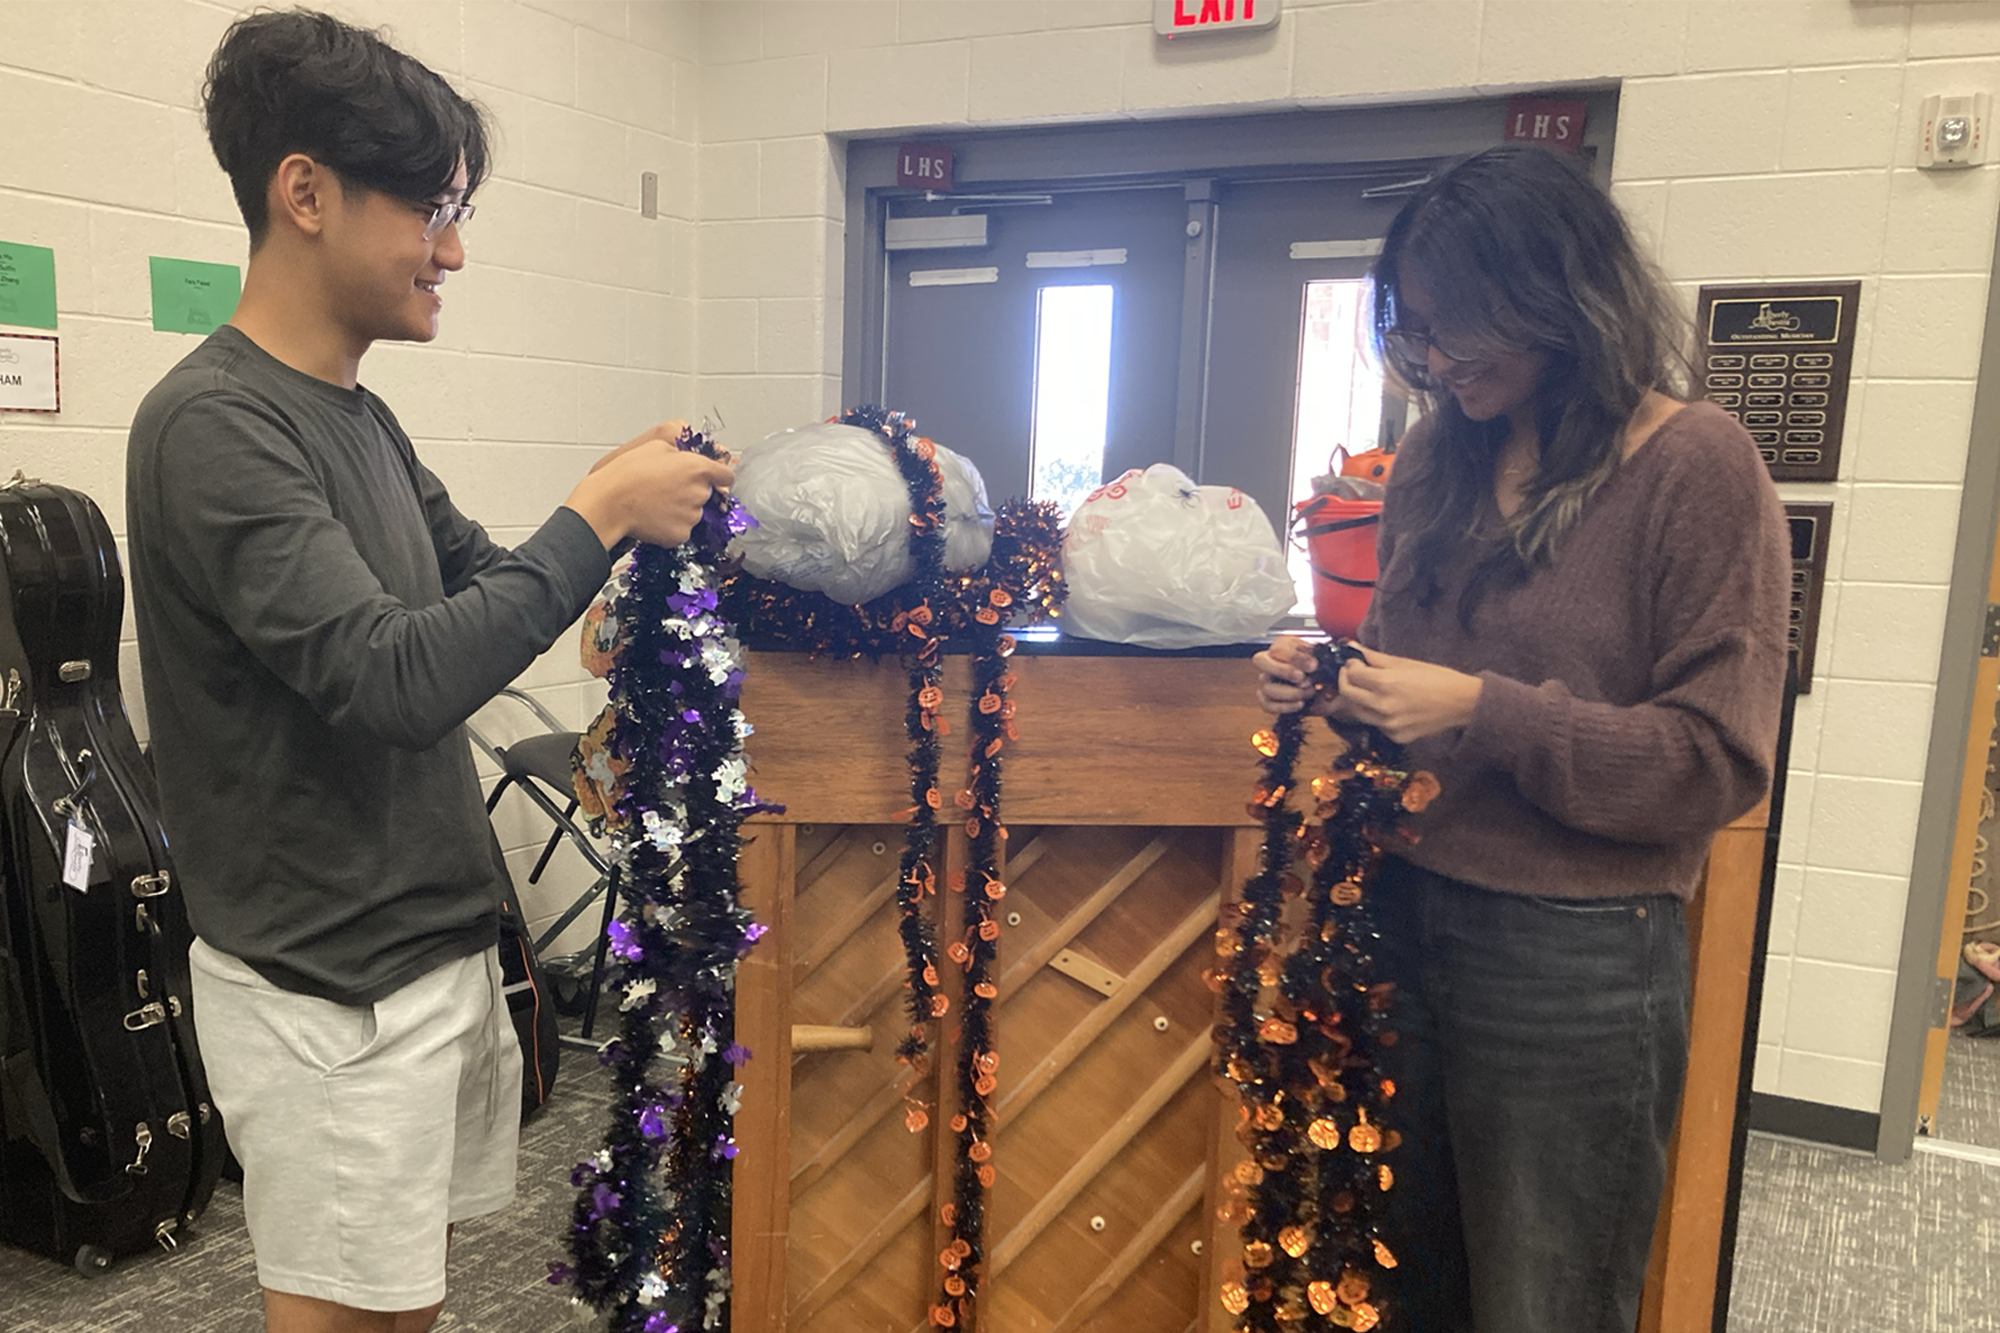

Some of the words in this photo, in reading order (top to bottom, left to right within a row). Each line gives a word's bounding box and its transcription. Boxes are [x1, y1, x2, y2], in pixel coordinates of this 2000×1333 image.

[1513, 113, 1570, 140] LHS
[1924, 120, 1932, 152] FIRE
[1973, 117, 1981, 150] FIRE
[904, 155, 944, 179] LHS
